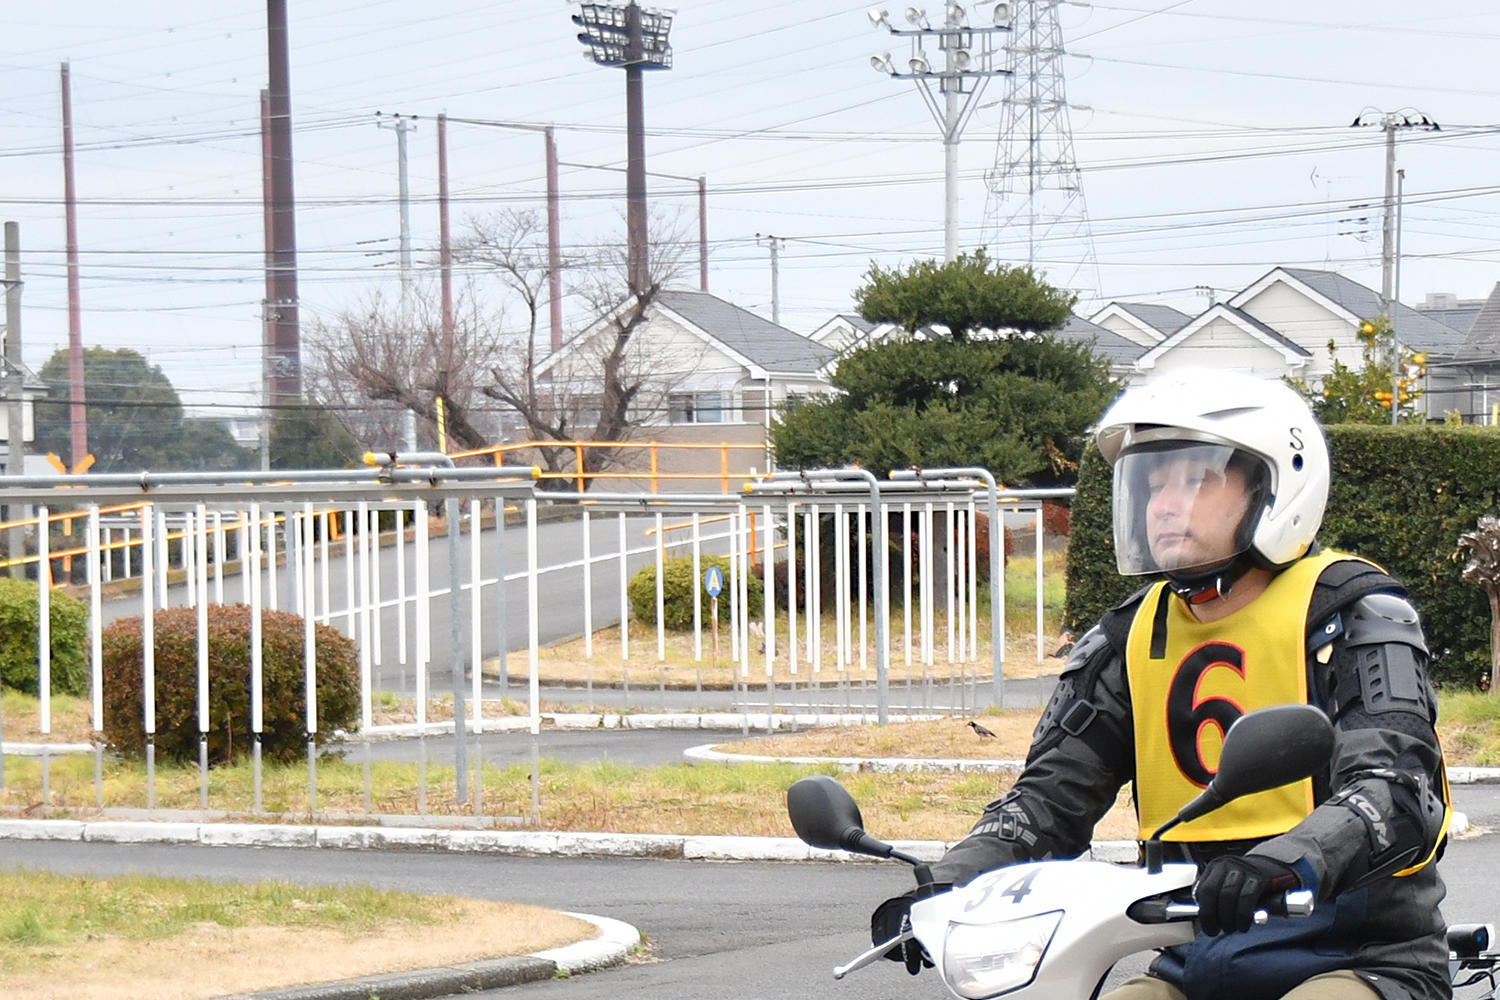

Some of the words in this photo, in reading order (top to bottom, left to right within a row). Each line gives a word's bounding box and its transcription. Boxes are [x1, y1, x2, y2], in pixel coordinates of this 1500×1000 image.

[1289, 427, 1304, 451] S
[708, 569, 721, 591] A
[1165, 639, 1246, 790] 6
[963, 866, 1042, 912] 34
